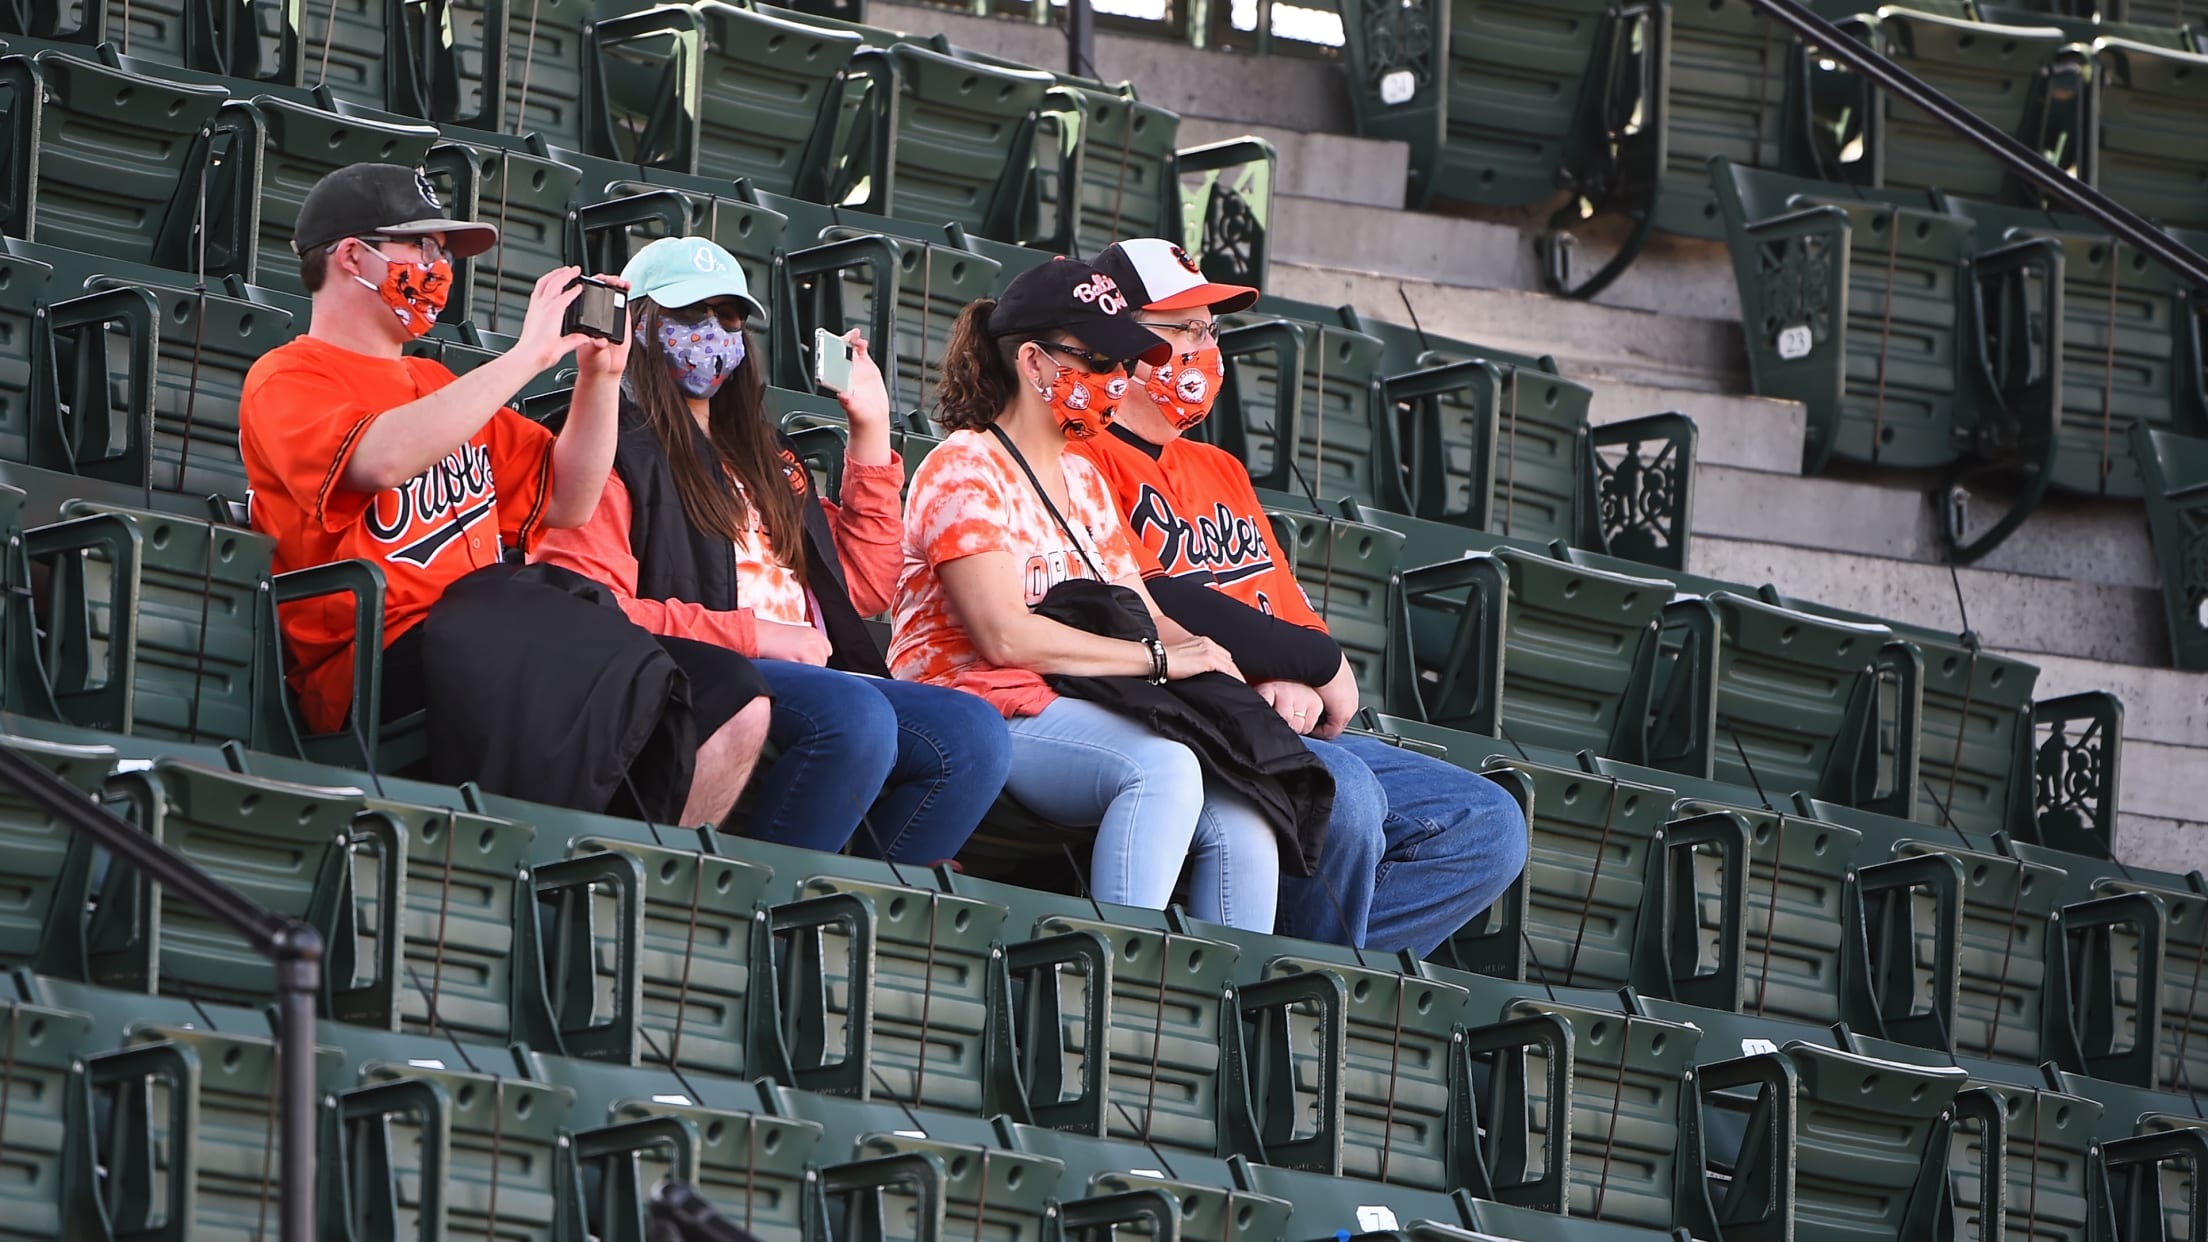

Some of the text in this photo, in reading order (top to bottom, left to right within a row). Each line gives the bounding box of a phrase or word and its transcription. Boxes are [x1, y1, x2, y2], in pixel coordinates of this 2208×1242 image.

[1389, 77, 1407, 98] 24
[1786, 331, 1806, 353] 23
[1130, 483, 1271, 573] Oroles
[1369, 1212, 1381, 1231] 7
